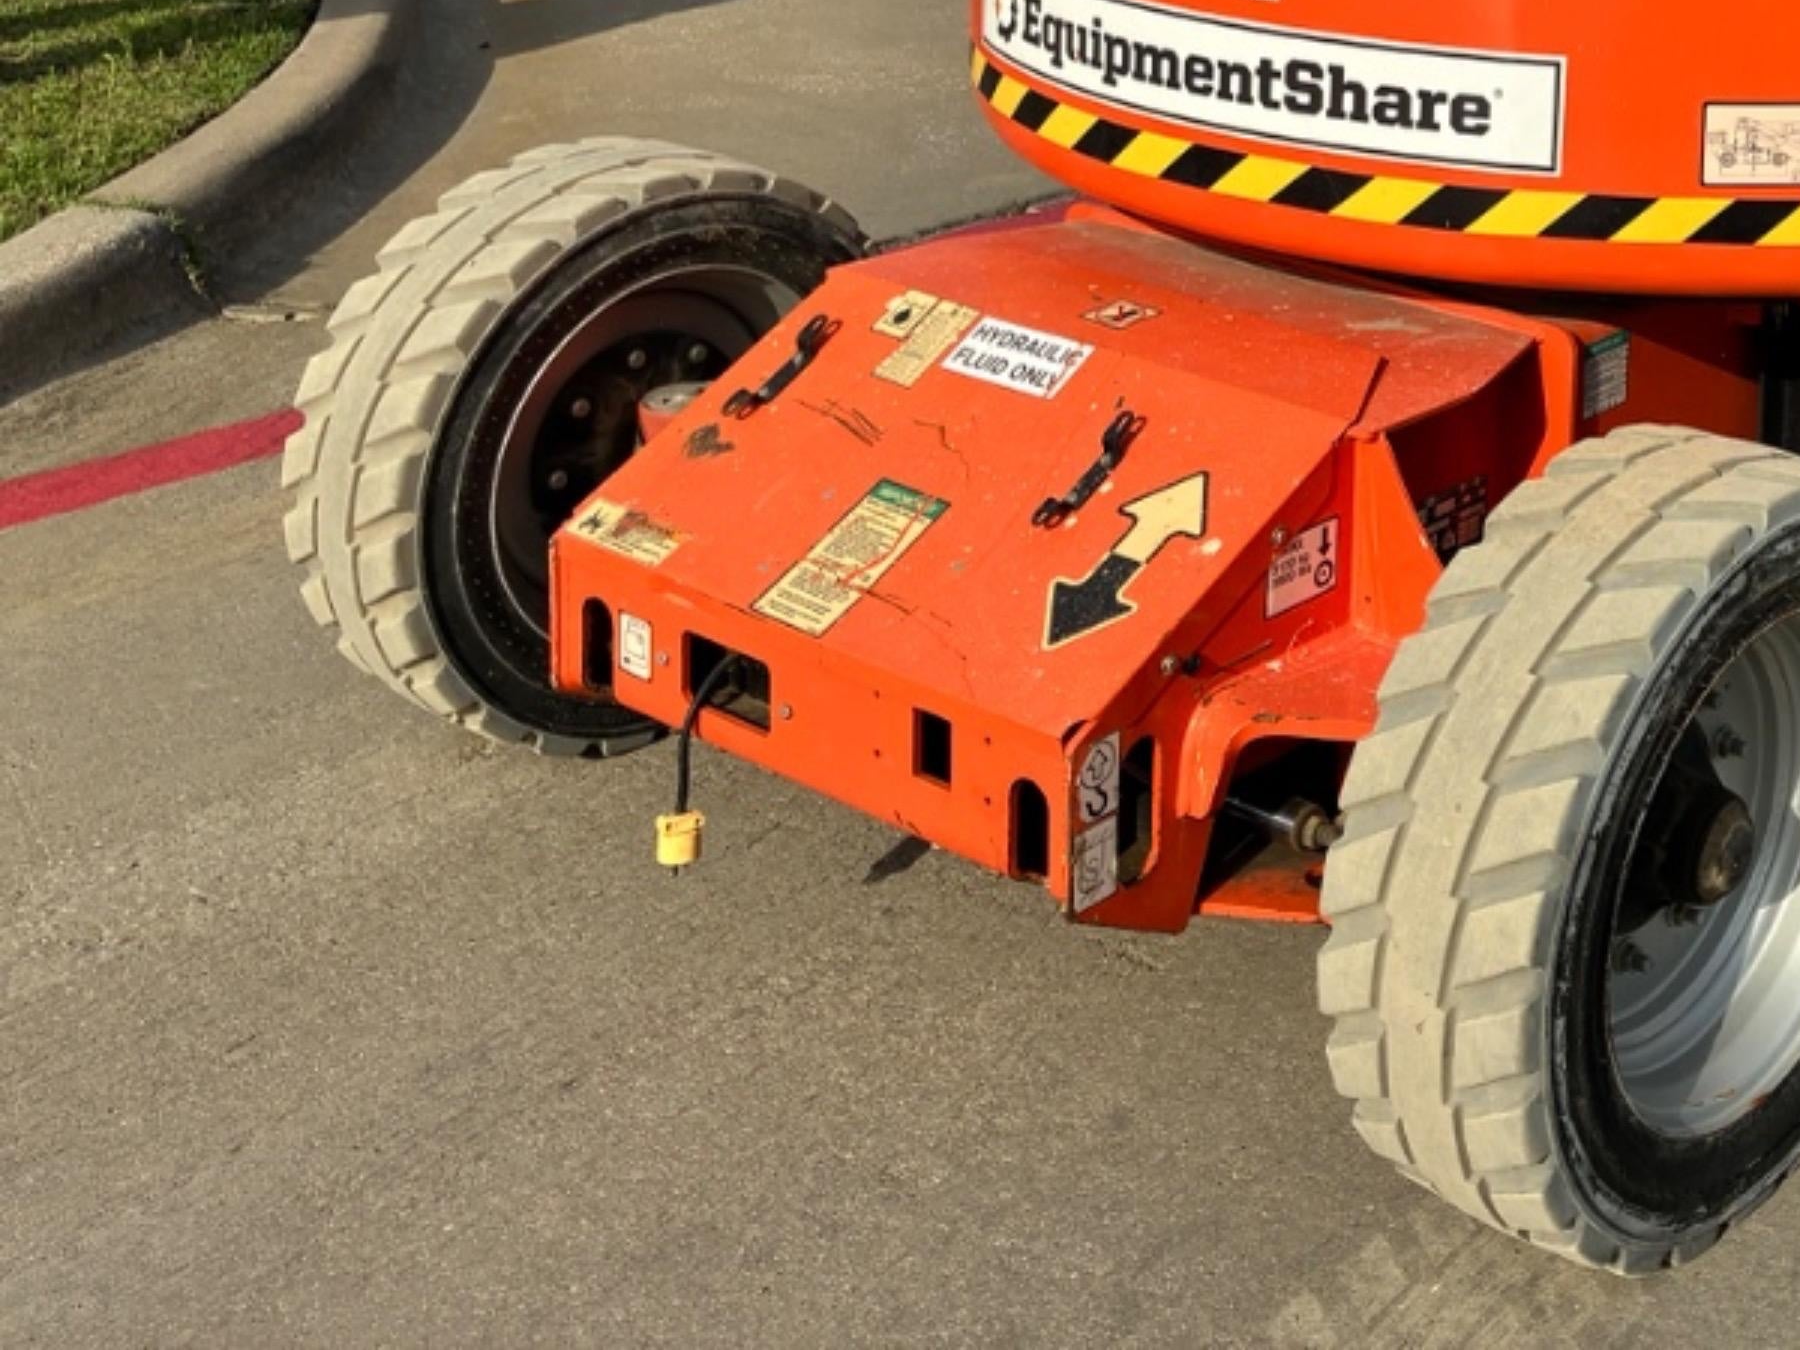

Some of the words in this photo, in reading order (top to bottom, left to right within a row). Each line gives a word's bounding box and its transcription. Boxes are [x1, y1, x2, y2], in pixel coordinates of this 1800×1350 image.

[971, 323, 1084, 368] HYDRAULIC
[952, 347, 1009, 376] FLUID
[1009, 363, 1058, 391] ONLY
